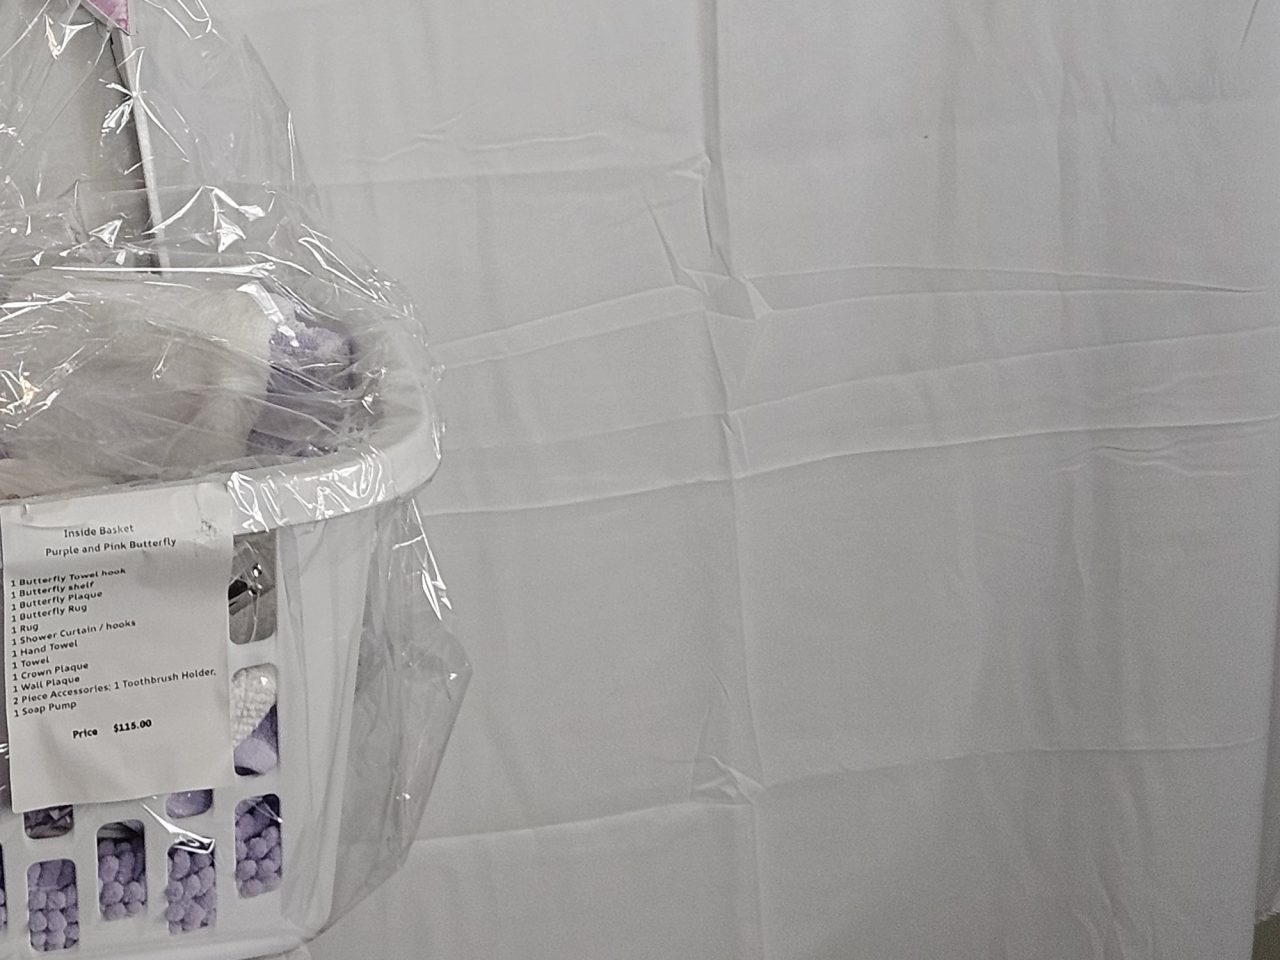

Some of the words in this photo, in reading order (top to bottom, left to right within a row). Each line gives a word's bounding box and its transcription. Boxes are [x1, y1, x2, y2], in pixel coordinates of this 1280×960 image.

[64, 528, 97, 538] Inside
[99, 524, 134, 535] Basket
[45, 545, 79, 557] Purple
[82, 544, 100, 554] and
[103, 541, 127, 551] Pink
[129, 537, 177, 549] Butterfly
[19, 575, 66, 586] Butterfly
[69, 571, 98, 581] Towel
[101, 567, 126, 577] hook
[11, 591, 16, 599] 1
[19, 585, 66, 597] Butterfly
[68, 581, 95, 591] shelf
[11, 603, 16, 611] 1
[19, 596, 65, 609] Butterfly
[68, 591, 103, 601] Plaque
[11, 615, 17, 623] 1
[19, 607, 65, 621] Butterfly
[68, 604, 88, 613] Rug
[11, 626, 17, 634] 1
[20, 623, 39, 633] Rug
[12, 638, 17, 646] 1
[20, 632, 58, 645] Shower
[60, 625, 97, 638] Curtain
[106, 620, 136, 630] hooks
[12, 650, 17, 658] 1
[20, 645, 47, 656] Hand
[49, 640, 78, 651] Towel
[21, 656, 50, 668] Towel
[12, 673, 18, 681] 1
[21, 669, 52, 680] Crown
[54, 663, 89, 674] Plaque
[13, 685, 18, 693] 1
[21, 680, 43, 691] Wall
[45, 676, 80, 687] Plaque
[13, 697, 19, 705] 2
[21, 692, 48, 703] Piece
[114, 681, 120, 690] 1
[122, 673, 179, 688] Toothbrush
[14, 709, 19, 718] 1
[22, 705, 46, 716] Soap
[48, 701, 77, 711] Pump
[73, 728, 98, 739] Price
[113, 719, 152, 733] $115.00
